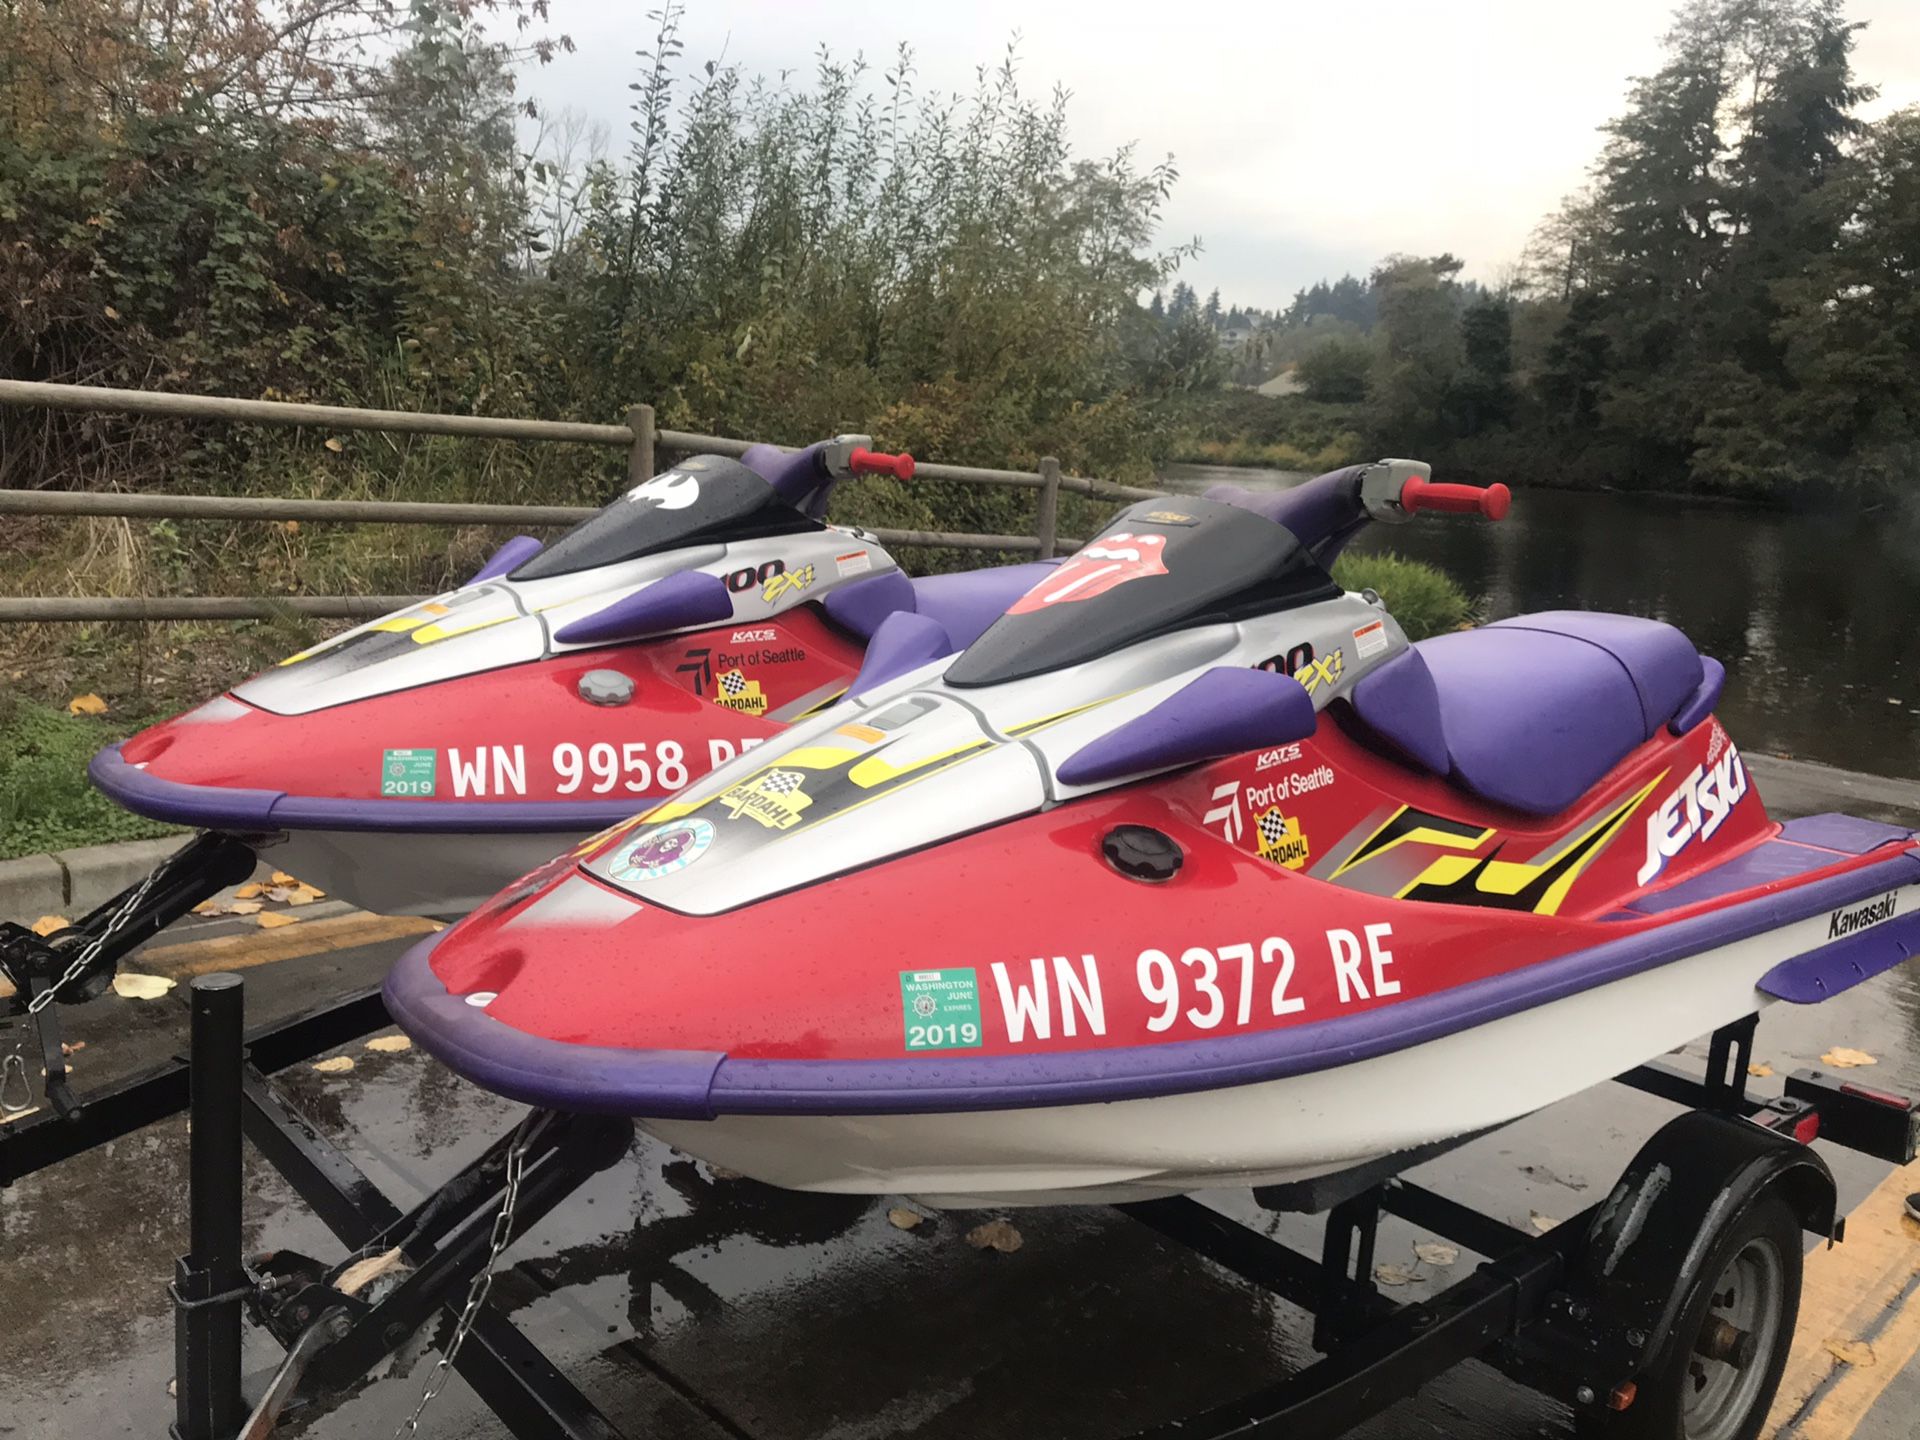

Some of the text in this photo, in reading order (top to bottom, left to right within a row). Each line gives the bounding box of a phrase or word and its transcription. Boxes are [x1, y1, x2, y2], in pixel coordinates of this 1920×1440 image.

[732, 629, 776, 641] KATS
[718, 648, 806, 668] Port of Seattle
[1257, 742, 1300, 767] KATS
[447, 745, 527, 798] WN
[552, 739, 689, 795] 9958
[384, 780, 433, 794] 2019
[1246, 764, 1335, 810] Port of Seattle
[725, 787, 793, 826] BARDAHL
[1258, 839, 1307, 865] ARDAHL
[1828, 890, 1898, 940] Kawasaki
[905, 980, 974, 992] WASHINGTON
[990, 922, 1402, 1043] WN 9372 RE
[947, 991, 974, 1001] JUNE
[909, 1022, 978, 1047] 2019
